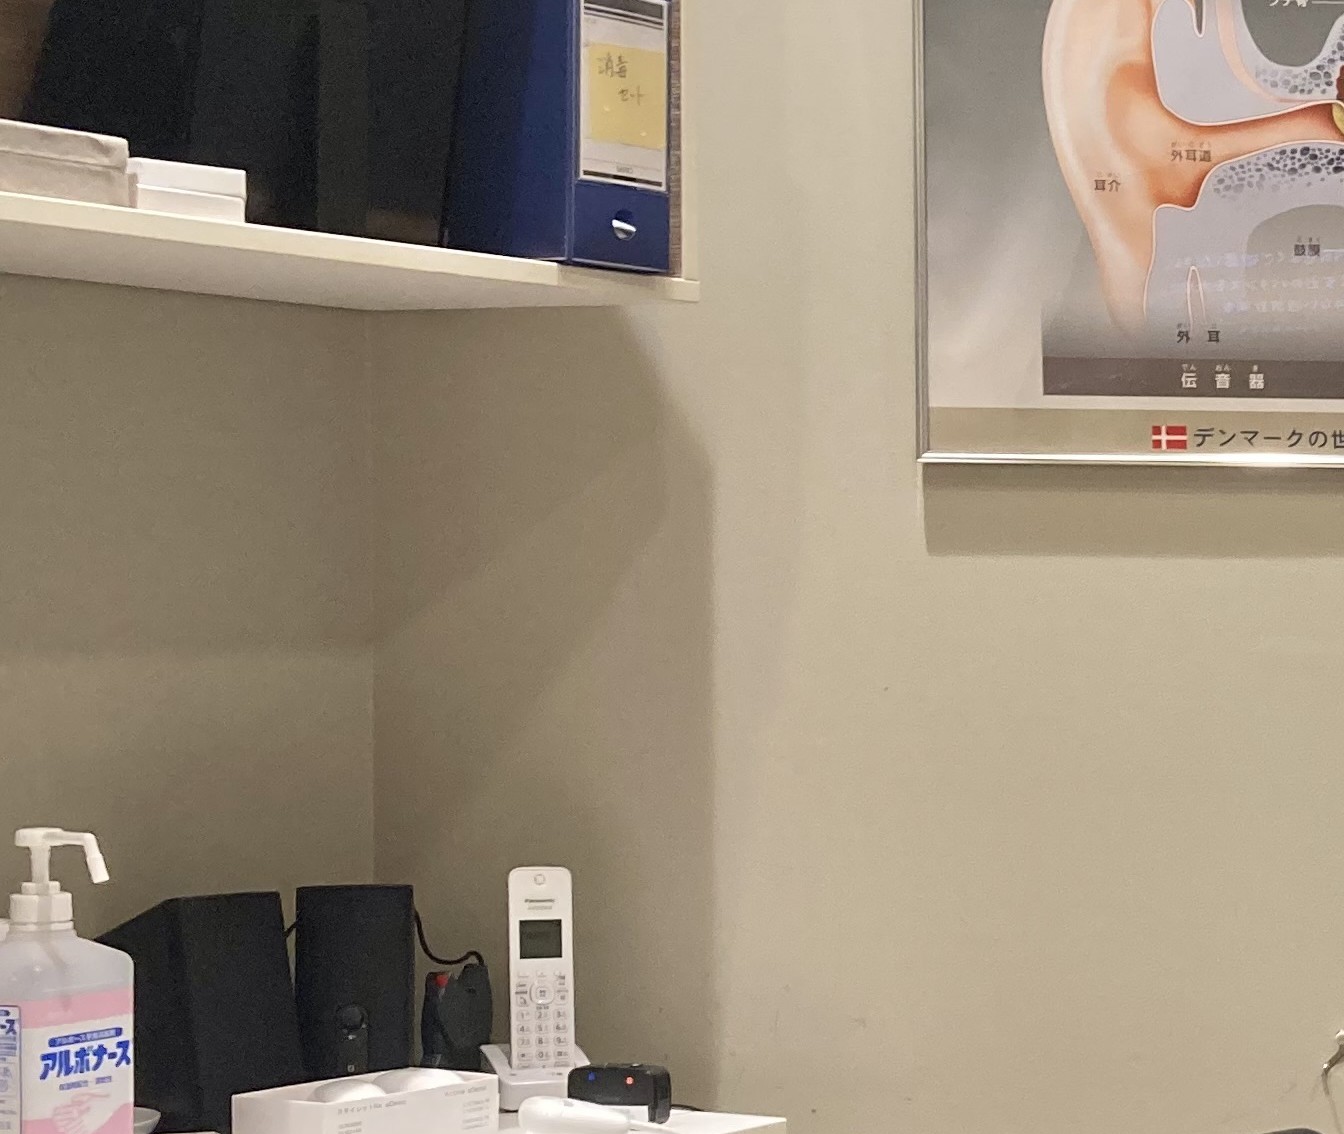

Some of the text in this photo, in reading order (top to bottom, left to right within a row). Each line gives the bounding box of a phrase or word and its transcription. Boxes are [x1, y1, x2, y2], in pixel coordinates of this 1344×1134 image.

[40, 1040, 131, 1080] アルボナース
